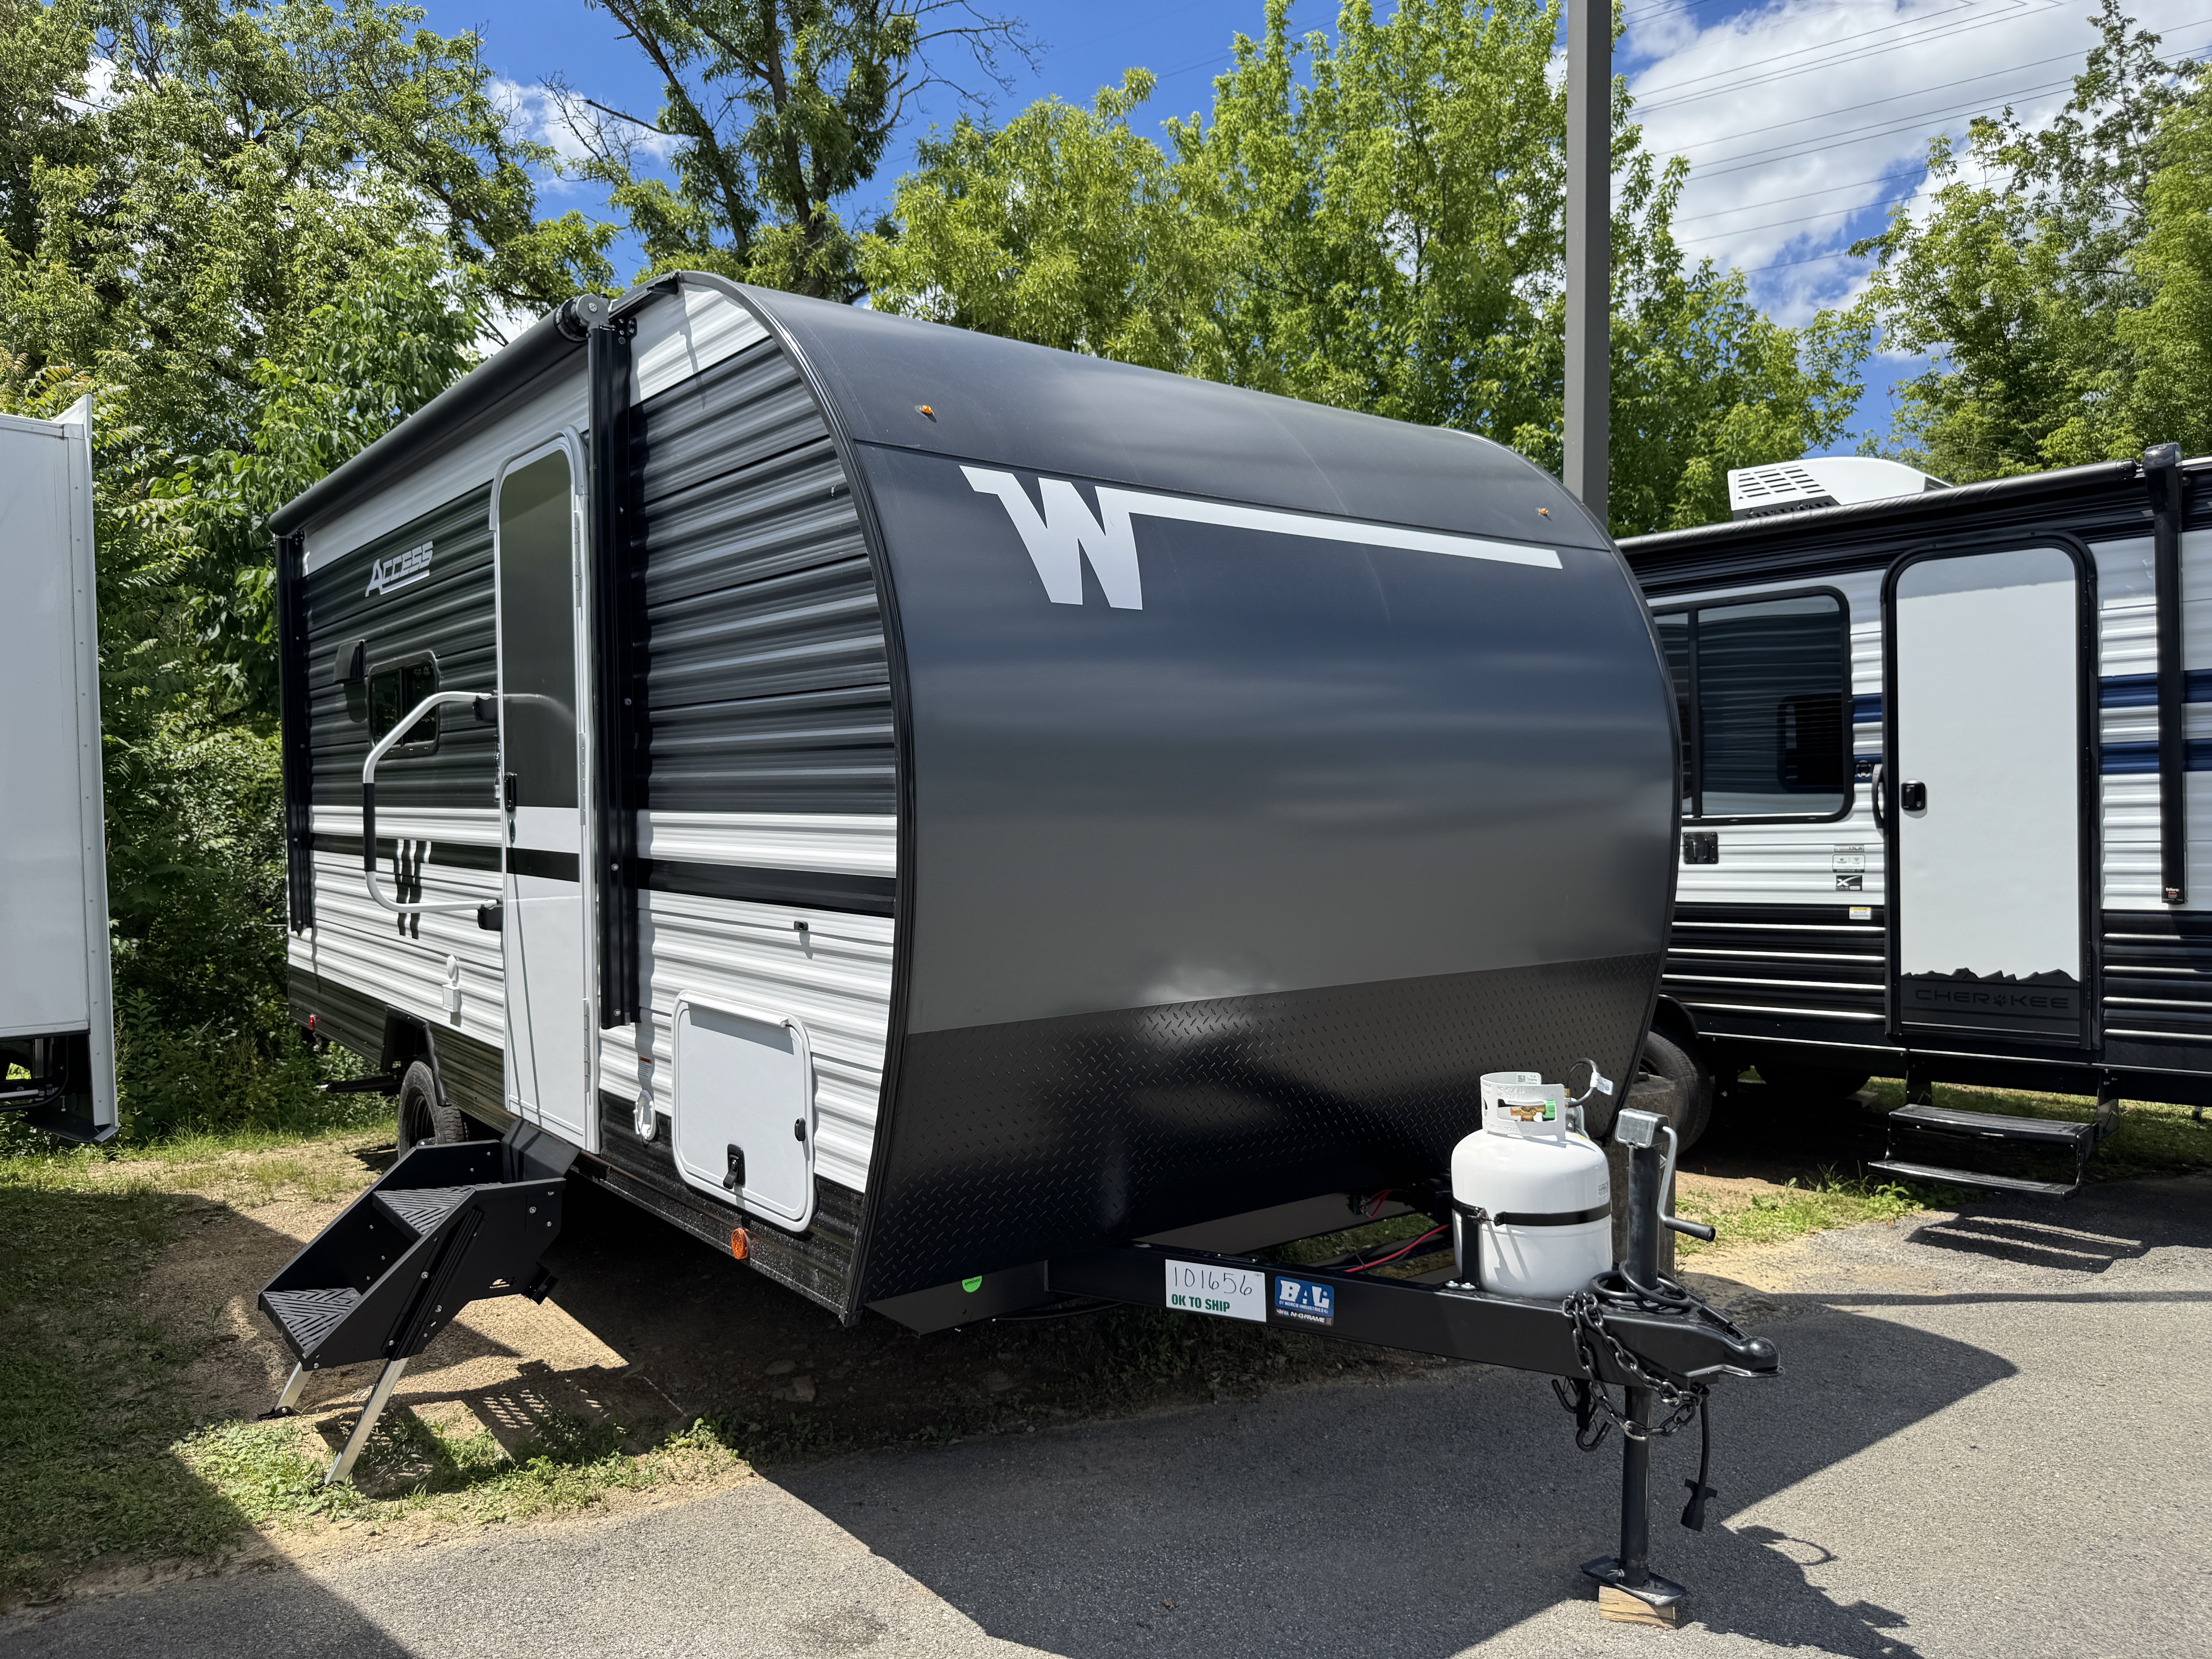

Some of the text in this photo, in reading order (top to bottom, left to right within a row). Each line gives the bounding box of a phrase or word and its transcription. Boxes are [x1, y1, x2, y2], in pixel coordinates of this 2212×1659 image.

[365, 541, 433, 597] ACCESS
[1175, 1266, 1252, 1296] 101656
[1171, 1294, 1230, 1312] OK TO SHIP
